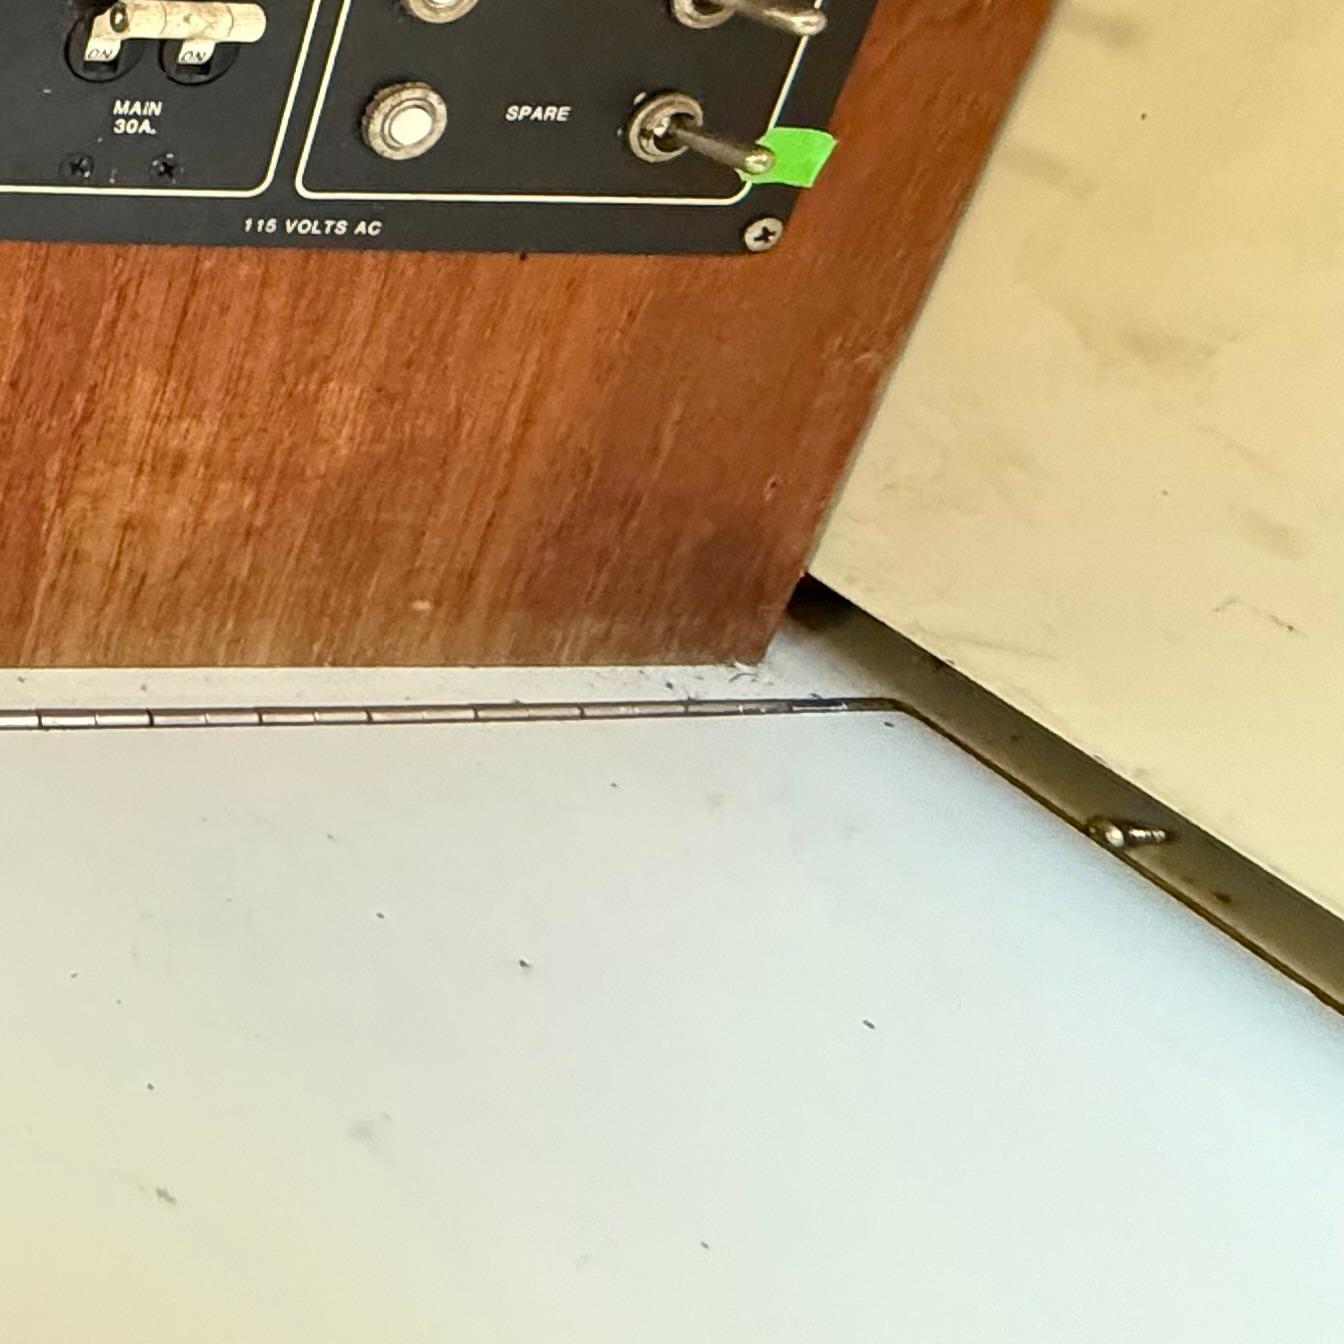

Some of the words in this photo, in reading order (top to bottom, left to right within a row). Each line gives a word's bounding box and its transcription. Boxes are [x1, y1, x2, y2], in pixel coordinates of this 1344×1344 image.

[113, 101, 162, 116] MAIN
[505, 104, 572, 122] SPARE
[113, 119, 156, 134] 30A.
[244, 218, 277, 233] 115
[285, 218, 348, 235] VOLTS
[353, 221, 382, 236] AC
